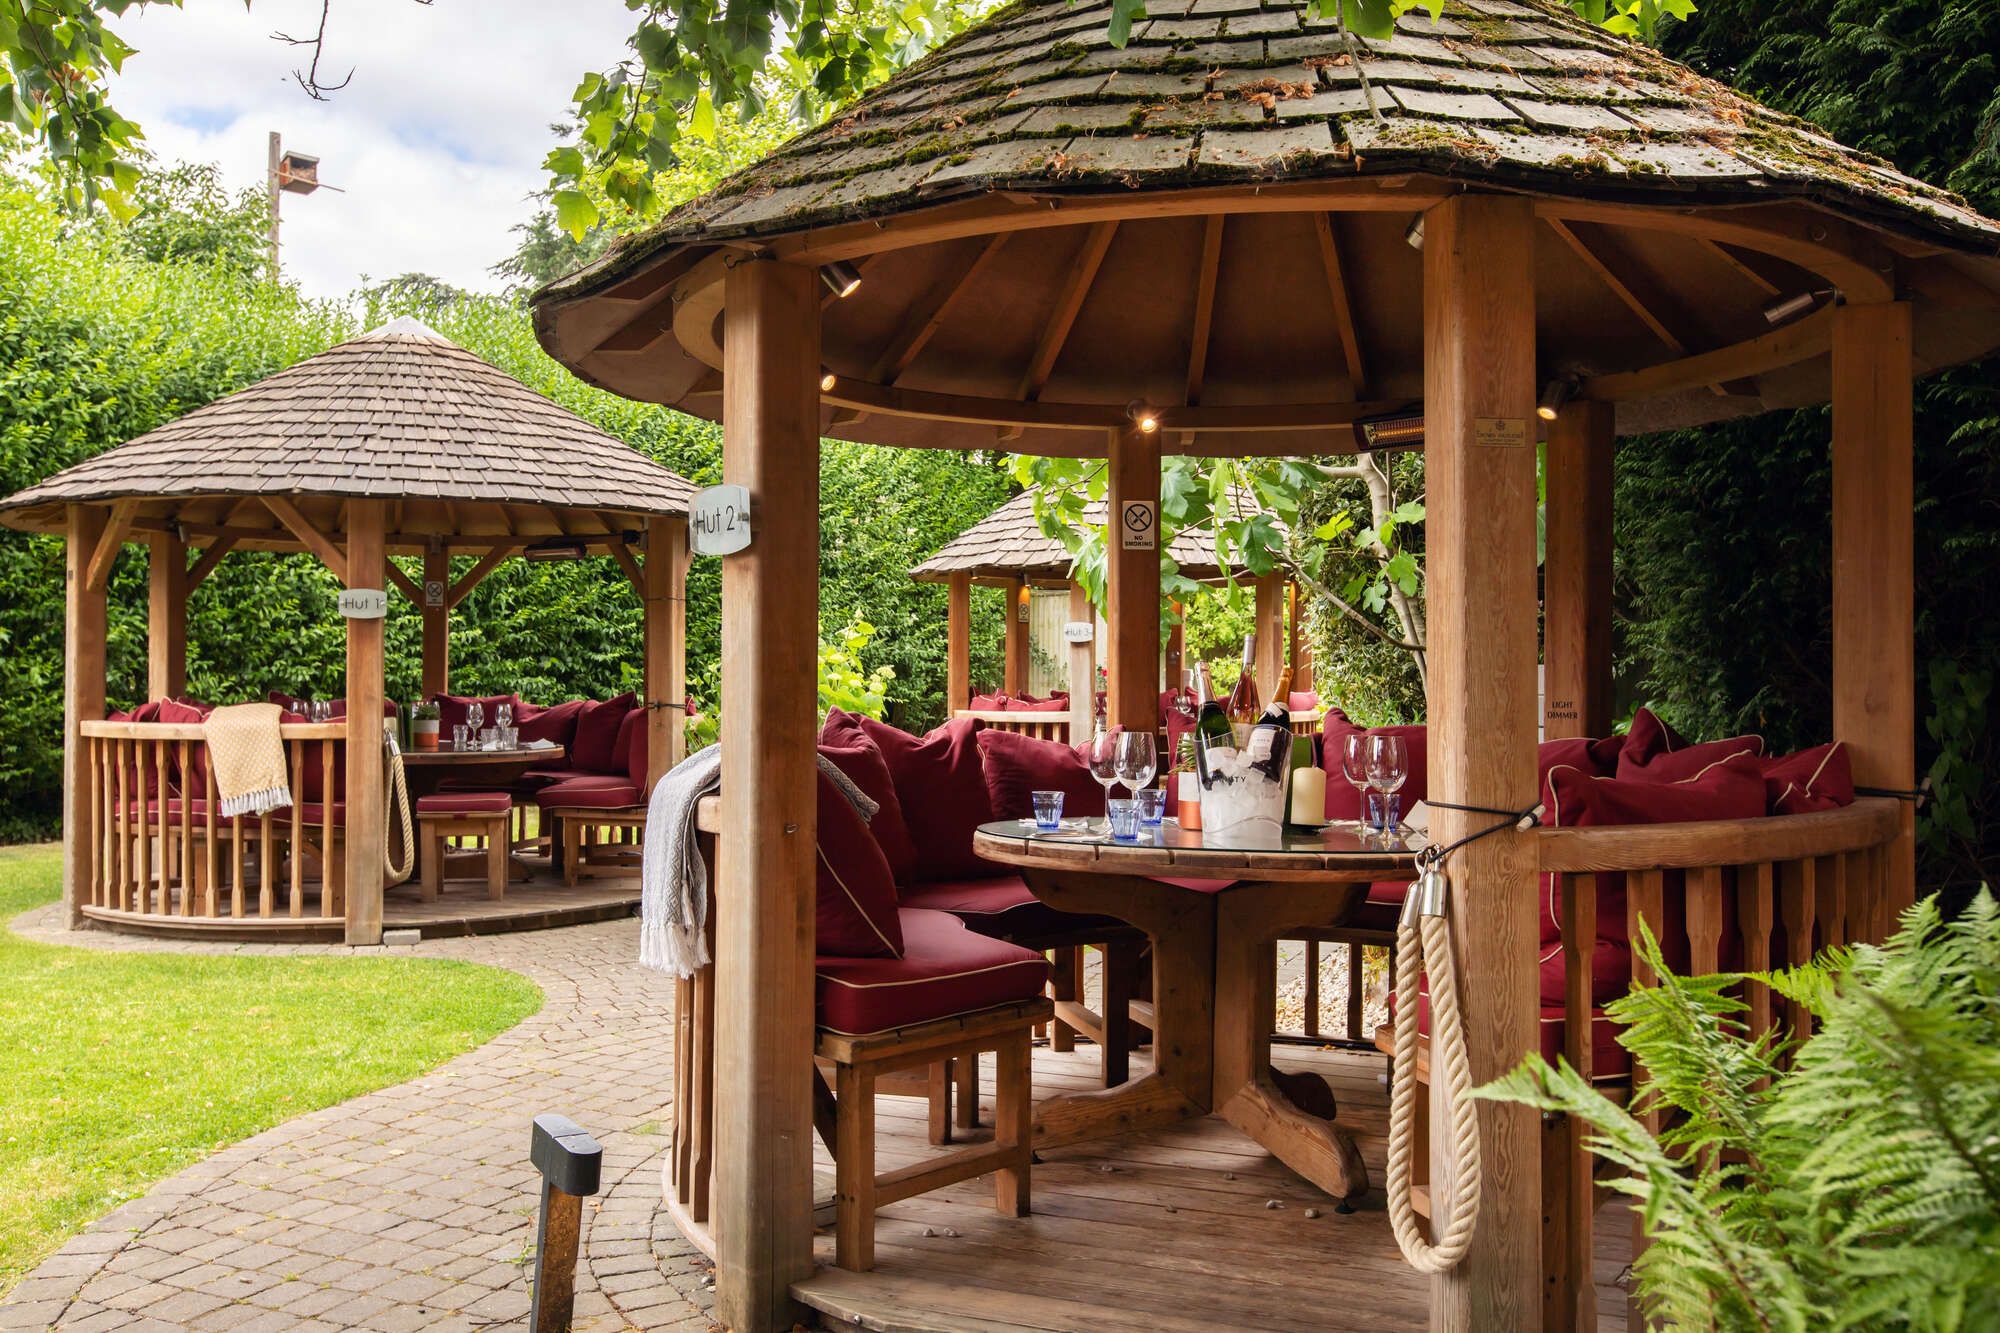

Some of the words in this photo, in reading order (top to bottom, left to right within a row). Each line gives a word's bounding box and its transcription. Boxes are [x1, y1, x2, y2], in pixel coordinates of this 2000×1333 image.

[695, 506, 721, 535] Hut
[726, 505, 735, 531] 2
[345, 597, 368, 610] Hut
[375, 598, 380, 609] 1
[1067, 628, 1081, 637] Hut
[1083, 627, 1089, 637] 3
[1552, 701, 1573, 709] LIGHT
[1548, 711, 1578, 720] DIMMER
